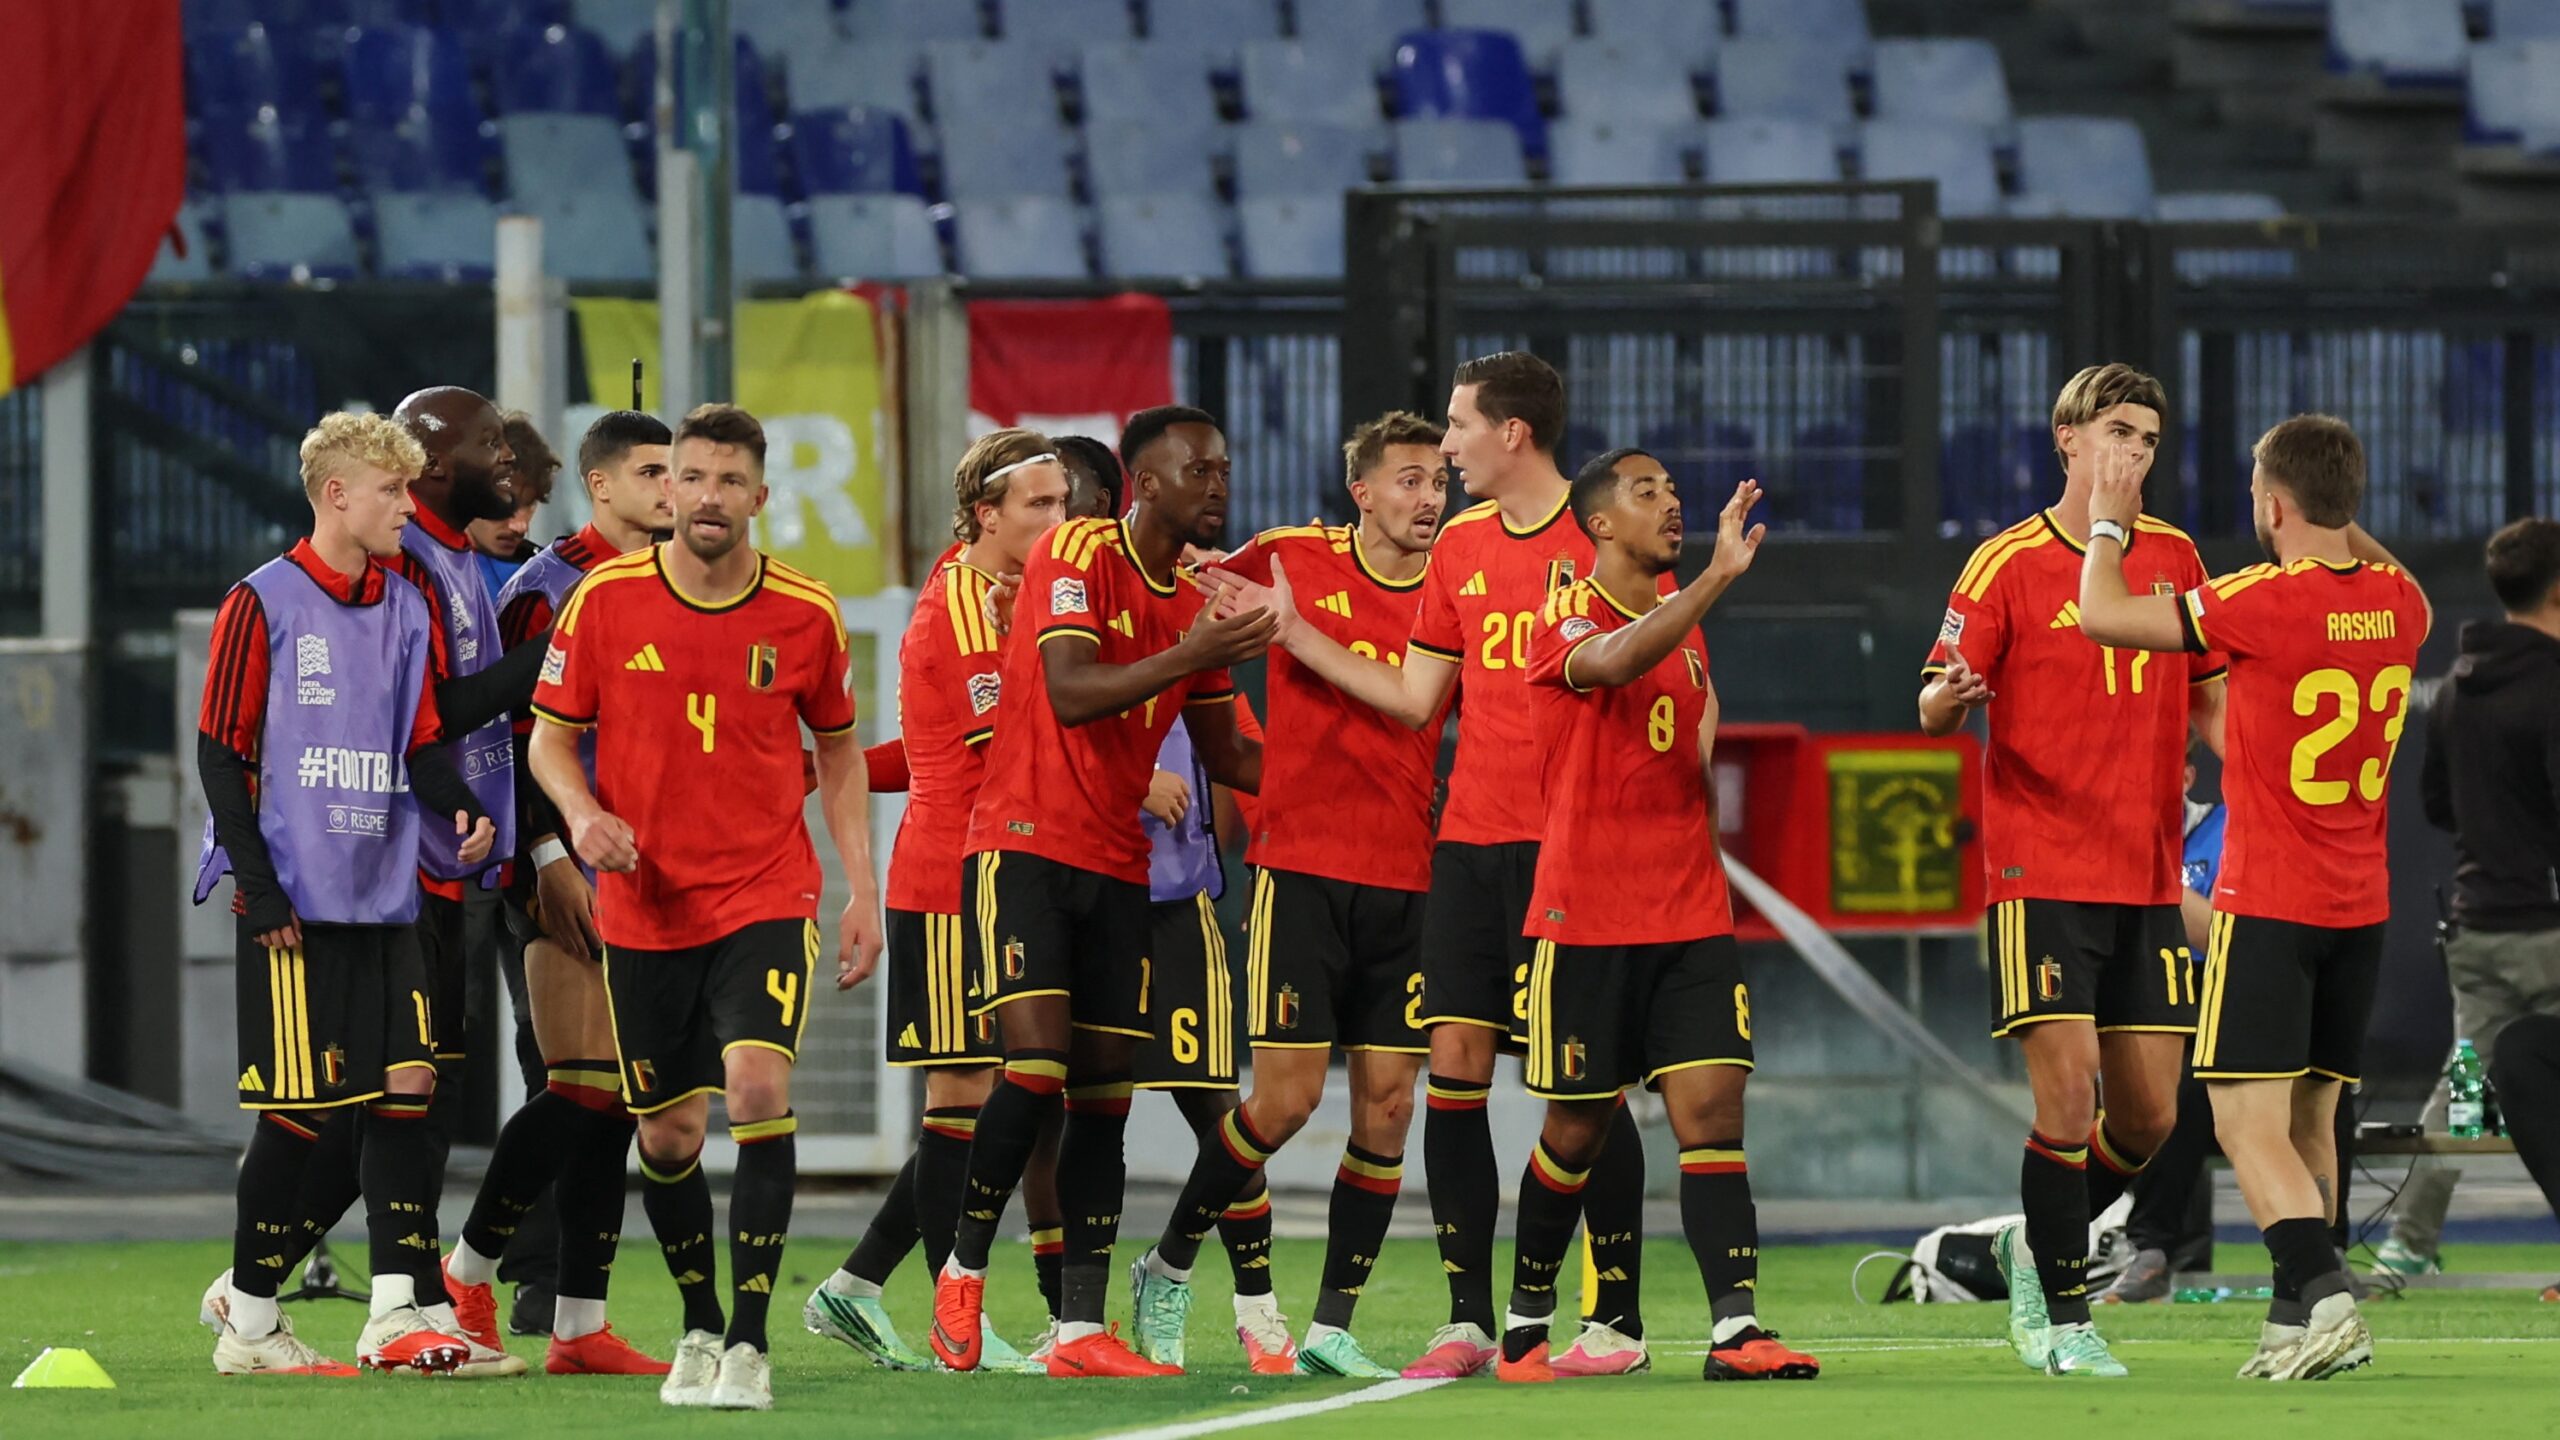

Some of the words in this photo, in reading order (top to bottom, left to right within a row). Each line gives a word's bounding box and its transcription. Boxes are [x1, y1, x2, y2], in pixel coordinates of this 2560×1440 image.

[1482, 611, 1535, 670] 20
[2327, 609, 2396, 641] RASKIN
[298, 687, 336, 697] NATIONS
[298, 696, 333, 705] LEAGUE
[302, 680, 321, 688] UEFA
[686, 692, 716, 754] 4
[1648, 695, 1675, 753] 8
[2289, 664, 2412, 806] 23
[766, 968, 798, 1027] 4
[2160, 946, 2195, 1006] 17
[1170, 1007, 1198, 1064] 6
[1734, 983, 1750, 1041] 8
